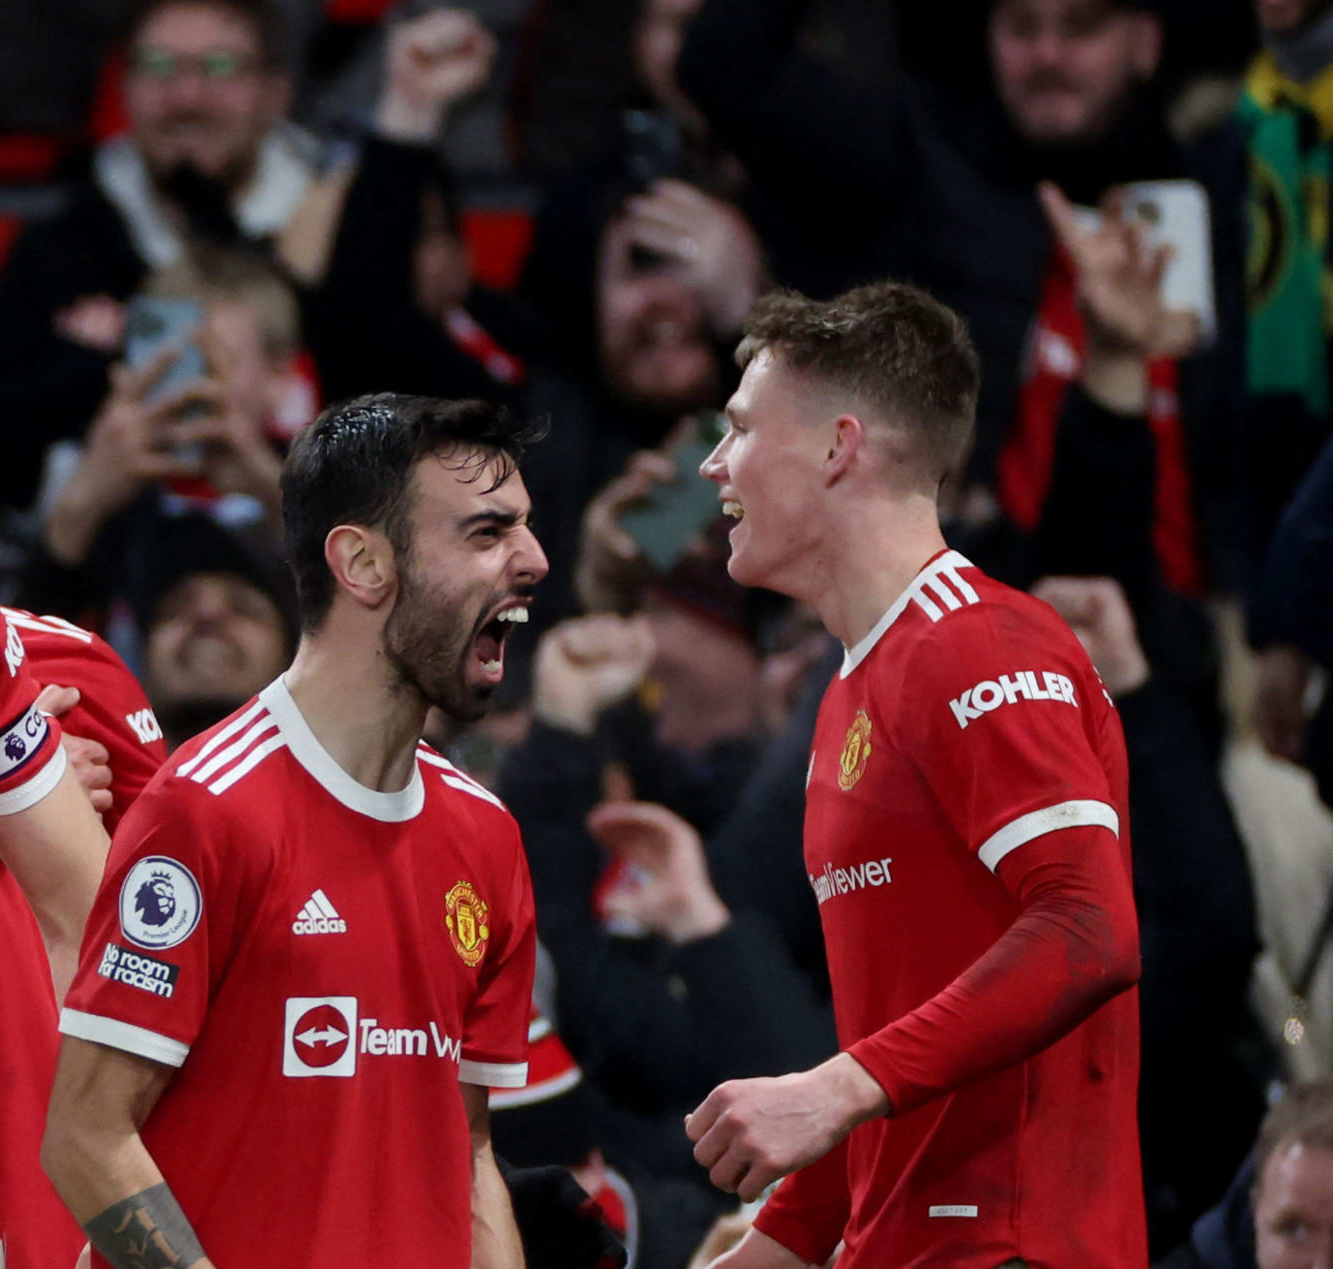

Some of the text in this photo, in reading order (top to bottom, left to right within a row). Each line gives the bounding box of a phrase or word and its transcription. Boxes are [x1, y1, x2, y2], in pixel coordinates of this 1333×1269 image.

[949, 670, 1079, 730] KOHLER
[291, 917, 348, 936] adidas
[113, 965, 174, 999] racism
[119, 952, 171, 981] room
